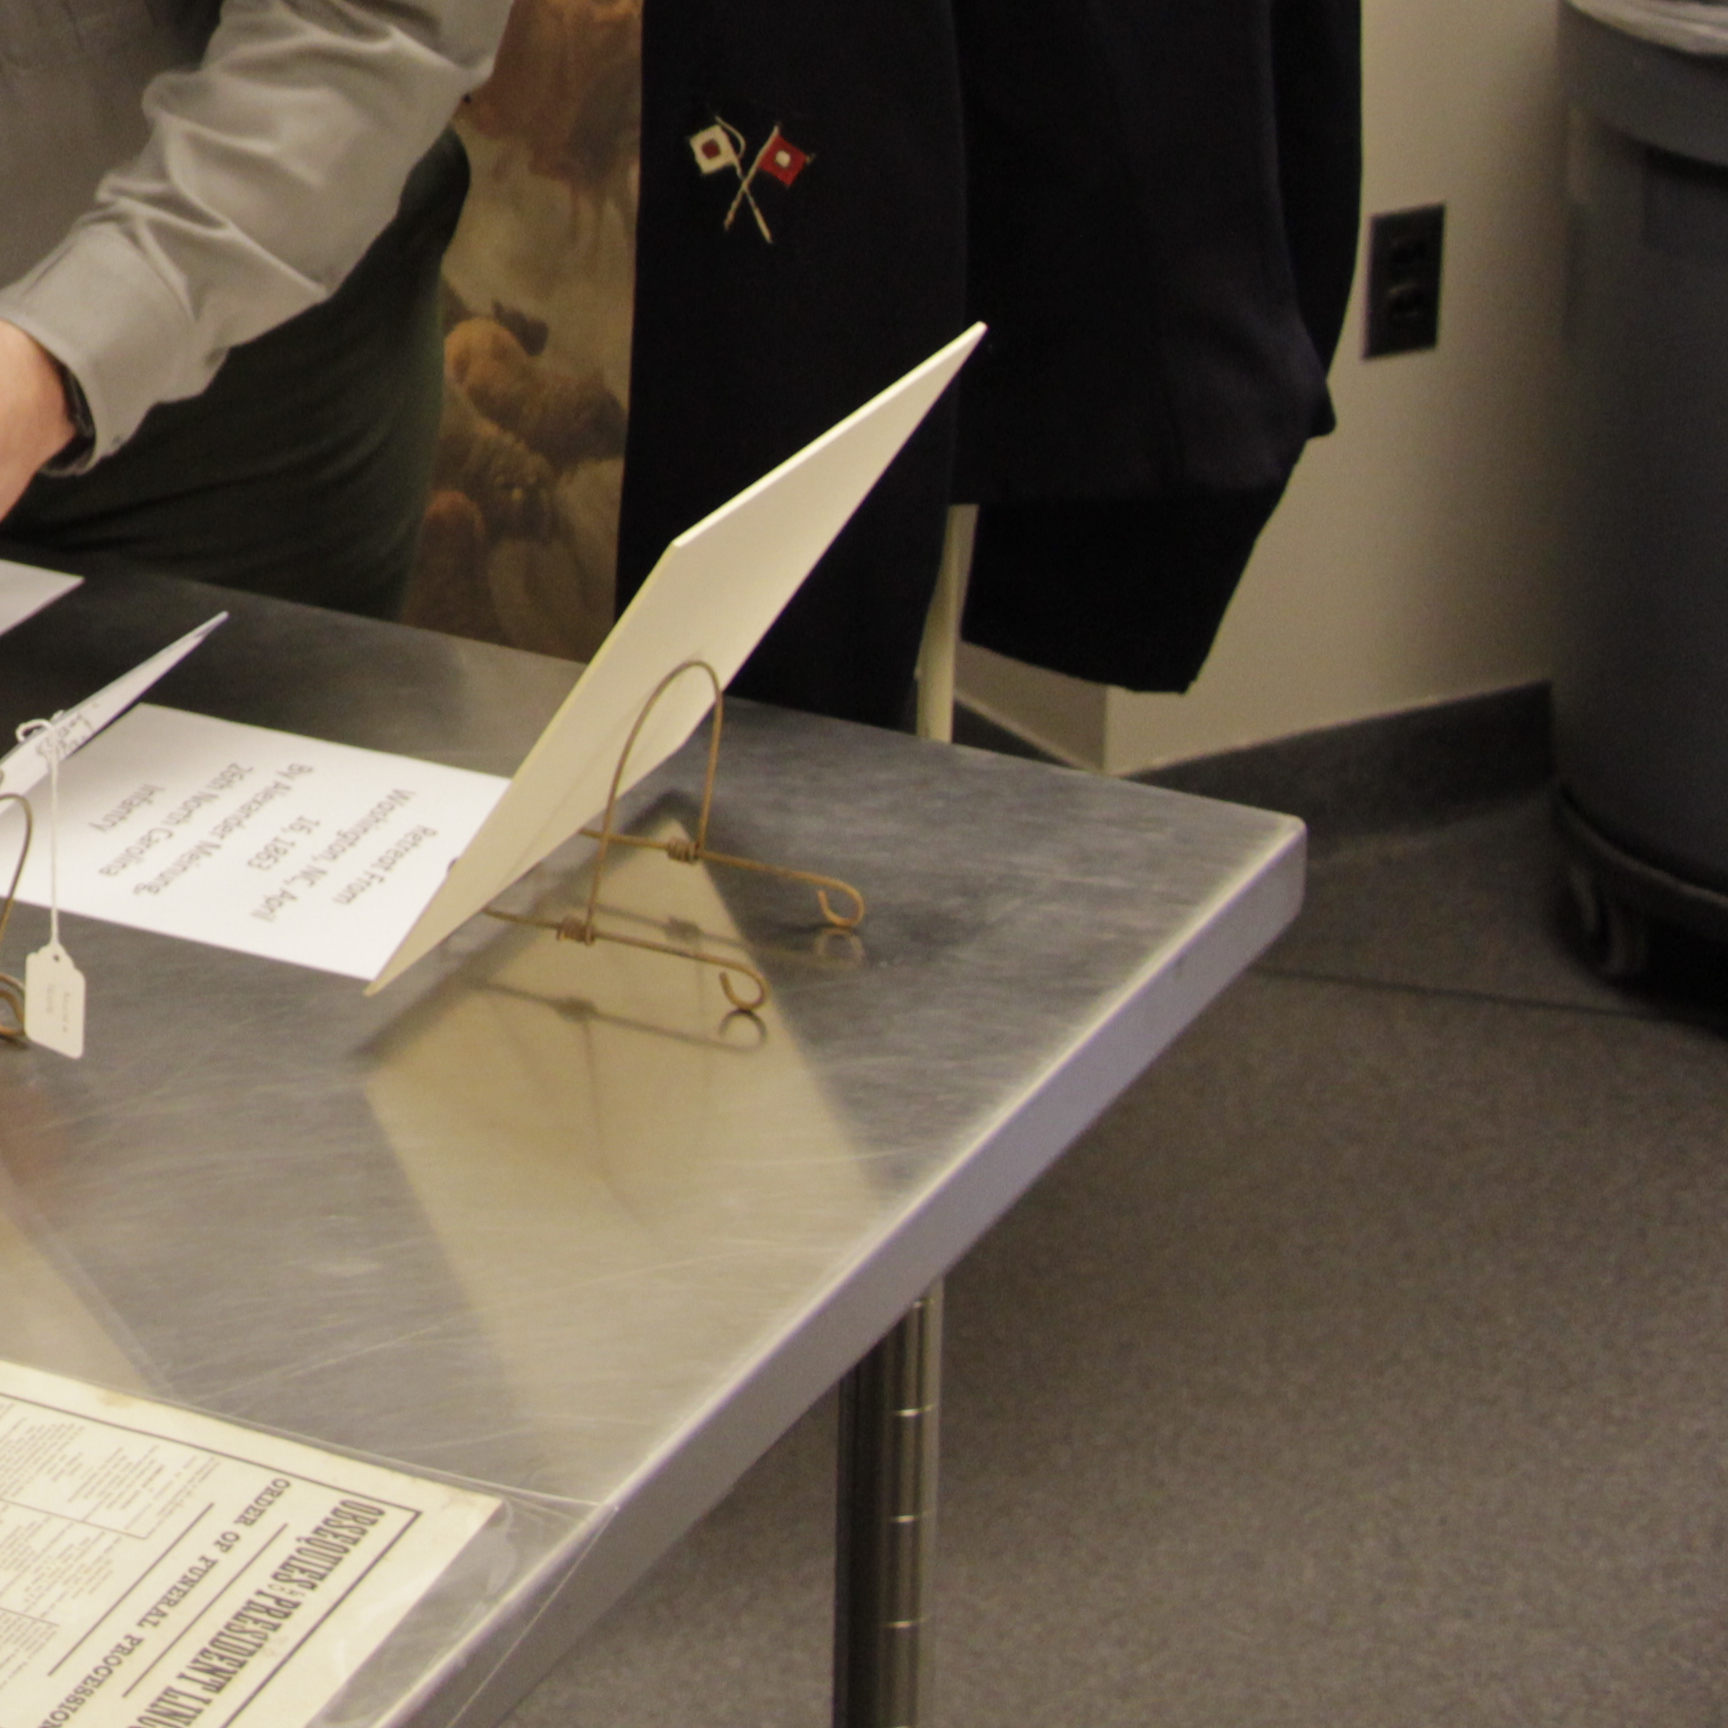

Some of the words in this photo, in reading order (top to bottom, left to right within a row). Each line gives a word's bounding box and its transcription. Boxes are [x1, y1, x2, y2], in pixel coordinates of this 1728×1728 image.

[211, 762, 254, 792] 26th
[276, 762, 314, 781] By
[88, 782, 166, 834] Infantry
[162, 790, 219, 828] North
[209, 779, 292, 840] Alexander
[281, 815, 321, 835] 16,
[312, 787, 416, 864] Washington,
[98, 825, 175, 877] Carolina
[246, 836, 297, 871] 1863
[370, 823, 438, 872] Retreat
[284, 864, 328, 888] NC,
[333, 870, 385, 905] From
[250, 887, 299, 923] April
[233, 1477, 292, 1528] ORDER
[213, 1531, 241, 1554] OF
[270, 1498, 387, 1590] OBSEQUIES
[136, 1554, 219, 1630] FUNERAL
[176, 1589, 302, 1706] PRESIDENT
